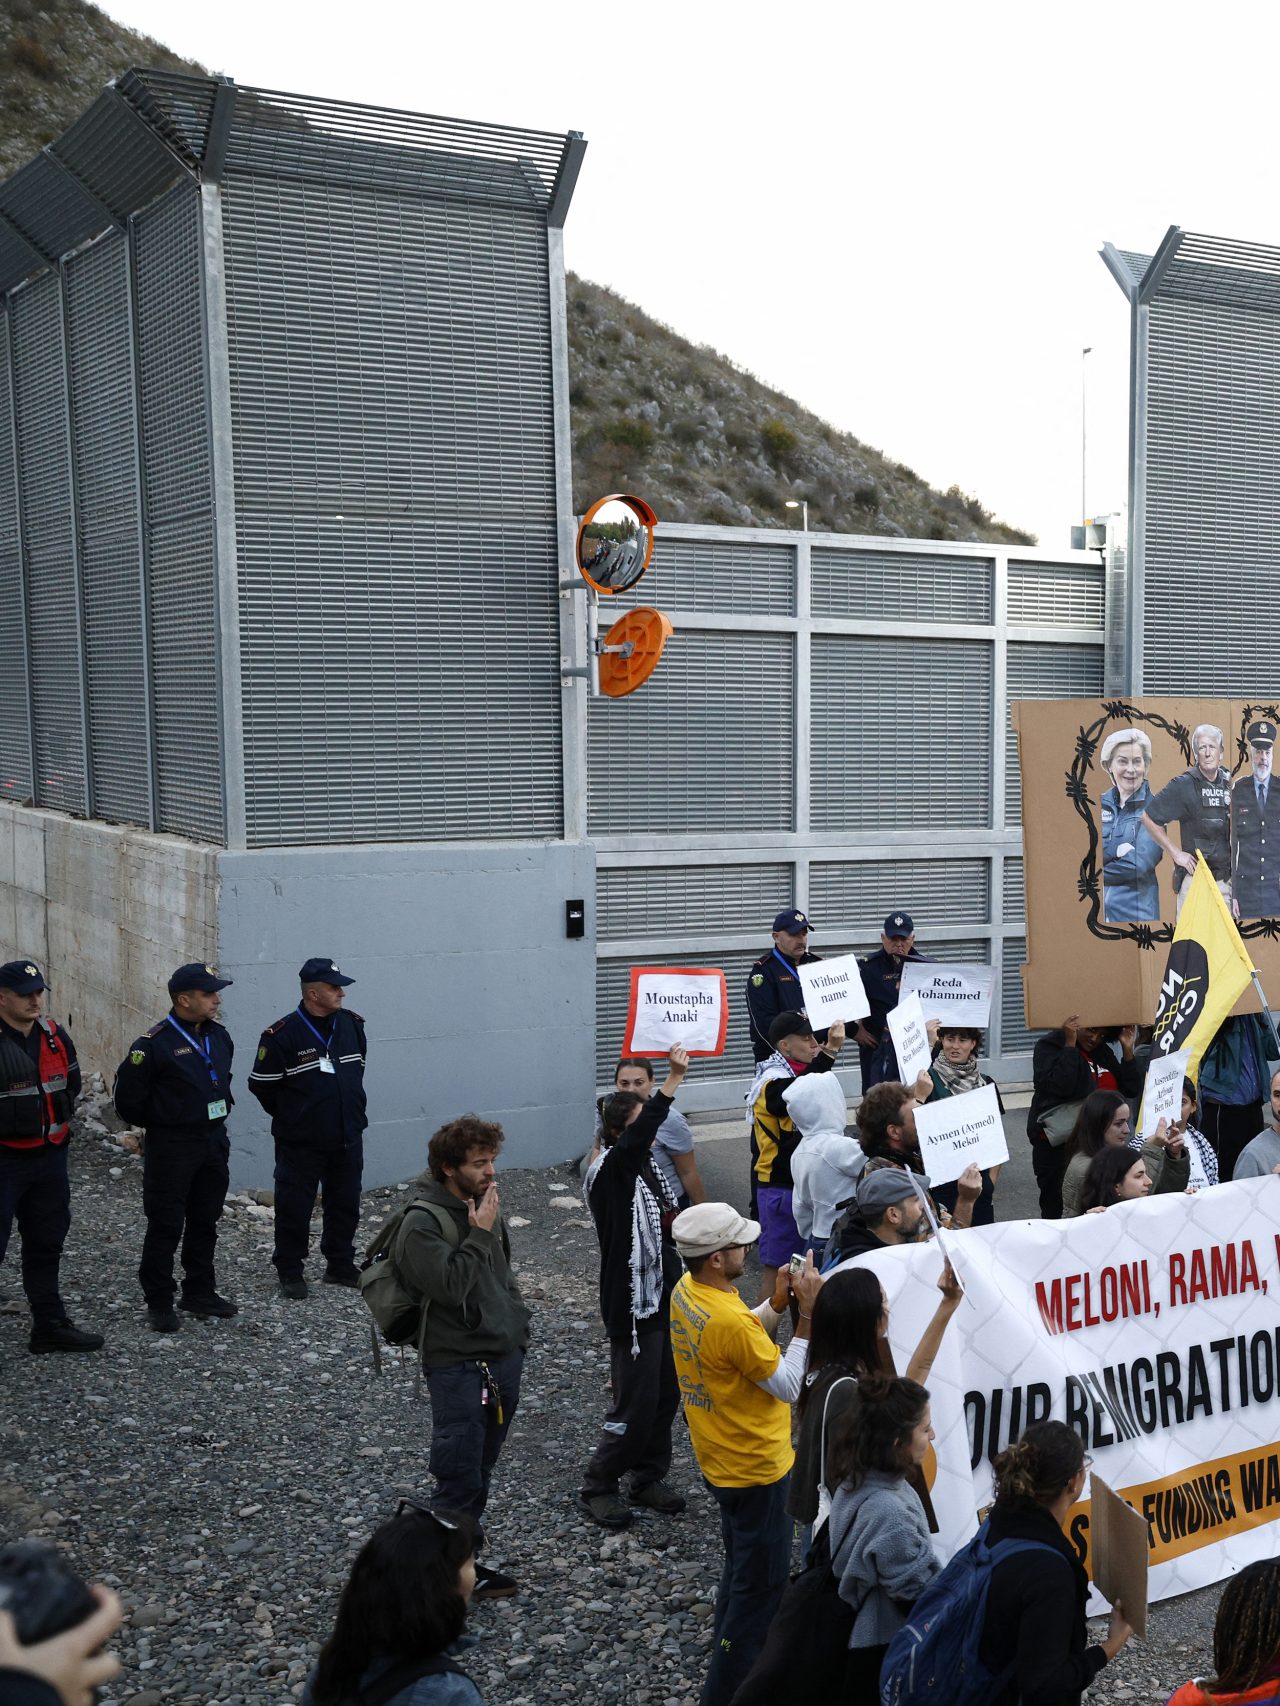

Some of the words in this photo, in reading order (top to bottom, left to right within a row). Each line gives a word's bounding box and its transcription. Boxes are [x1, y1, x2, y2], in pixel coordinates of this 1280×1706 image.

[1202, 788, 1224, 797] POLICE
[1209, 797, 1220, 806] ICE
[809, 971, 850, 989] Without
[932, 978, 962, 987] Reda
[645, 992, 714, 1007] Moustapha
[821, 990, 848, 1004] name
[662, 1010, 698, 1022] Anaki
[927, 1128, 960, 1146] Aymen
[961, 1114, 995, 1135] (Aymed)
[952, 1133, 980, 1151] Mekni
[1035, 1259, 1161, 1337] MELONI,
[1169, 1239, 1268, 1308] RAMA,
